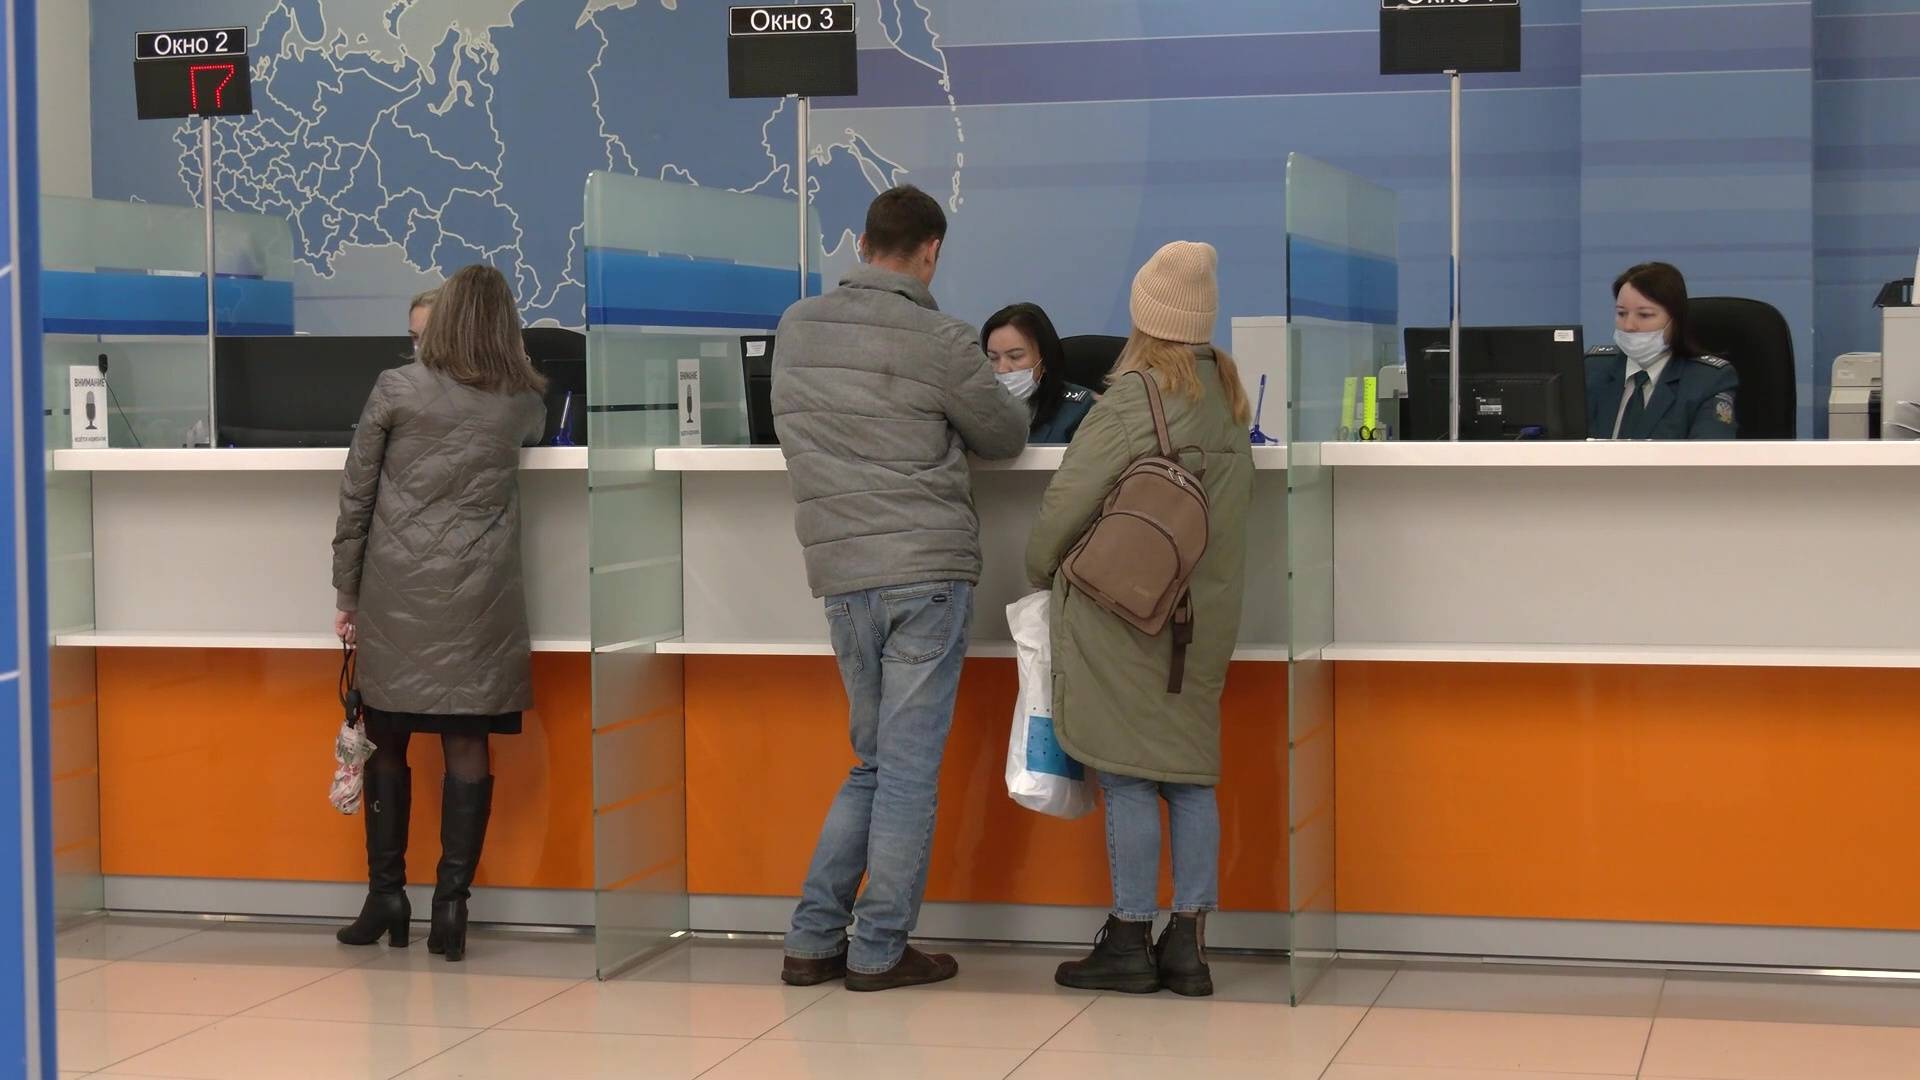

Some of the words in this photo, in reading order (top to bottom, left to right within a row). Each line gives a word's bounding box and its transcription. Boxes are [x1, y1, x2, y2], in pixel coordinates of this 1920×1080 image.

[750, 9, 812, 31] Окно
[819, 8, 834, 30] 3
[154, 34, 209, 56] Окно
[215, 31, 228, 53] 2
